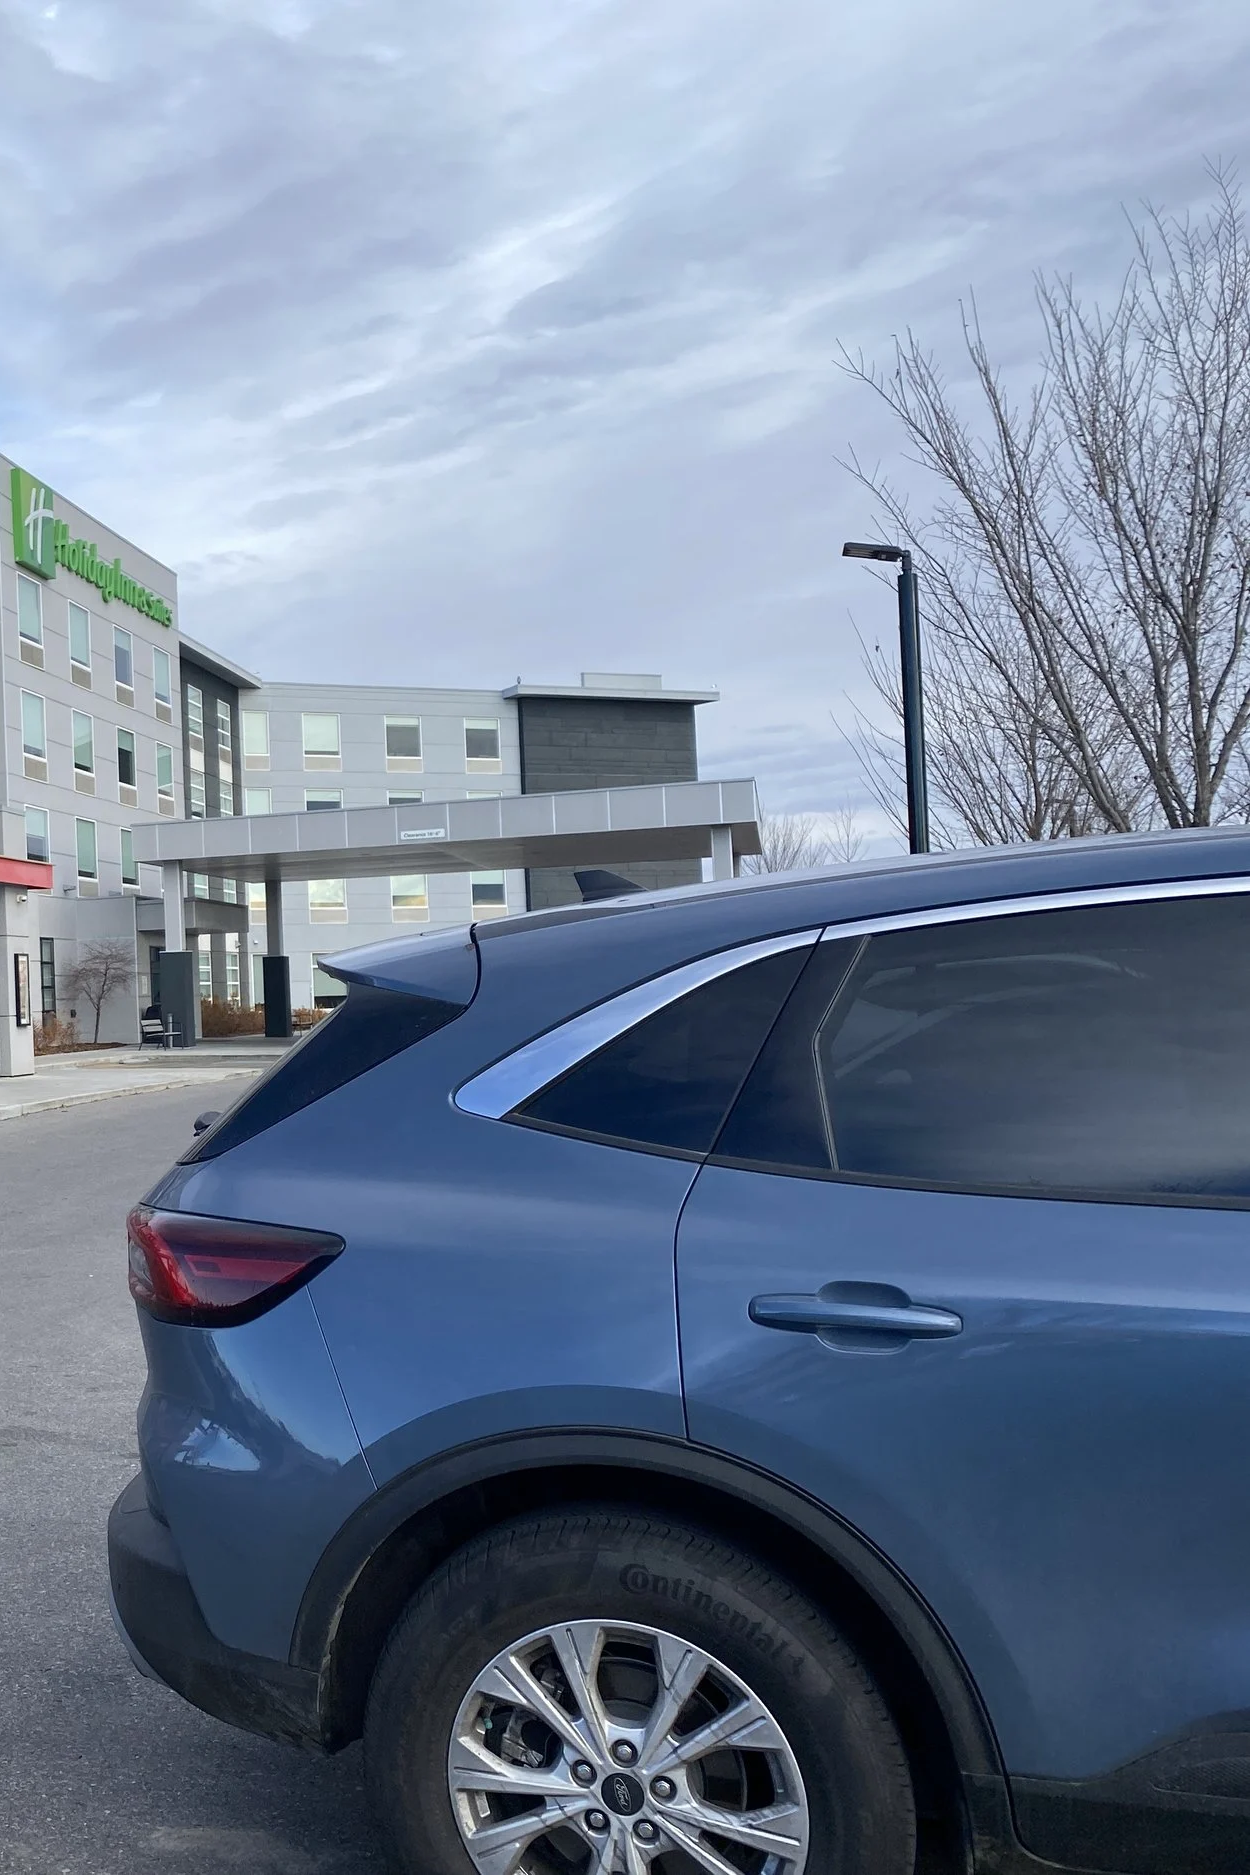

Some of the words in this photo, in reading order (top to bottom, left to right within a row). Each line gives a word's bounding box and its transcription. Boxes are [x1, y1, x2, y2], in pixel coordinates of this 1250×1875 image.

[53, 519, 115, 604] Holiday
[618, 1563, 788, 1660] Continental
[616, 1784, 629, 1806] Ford
